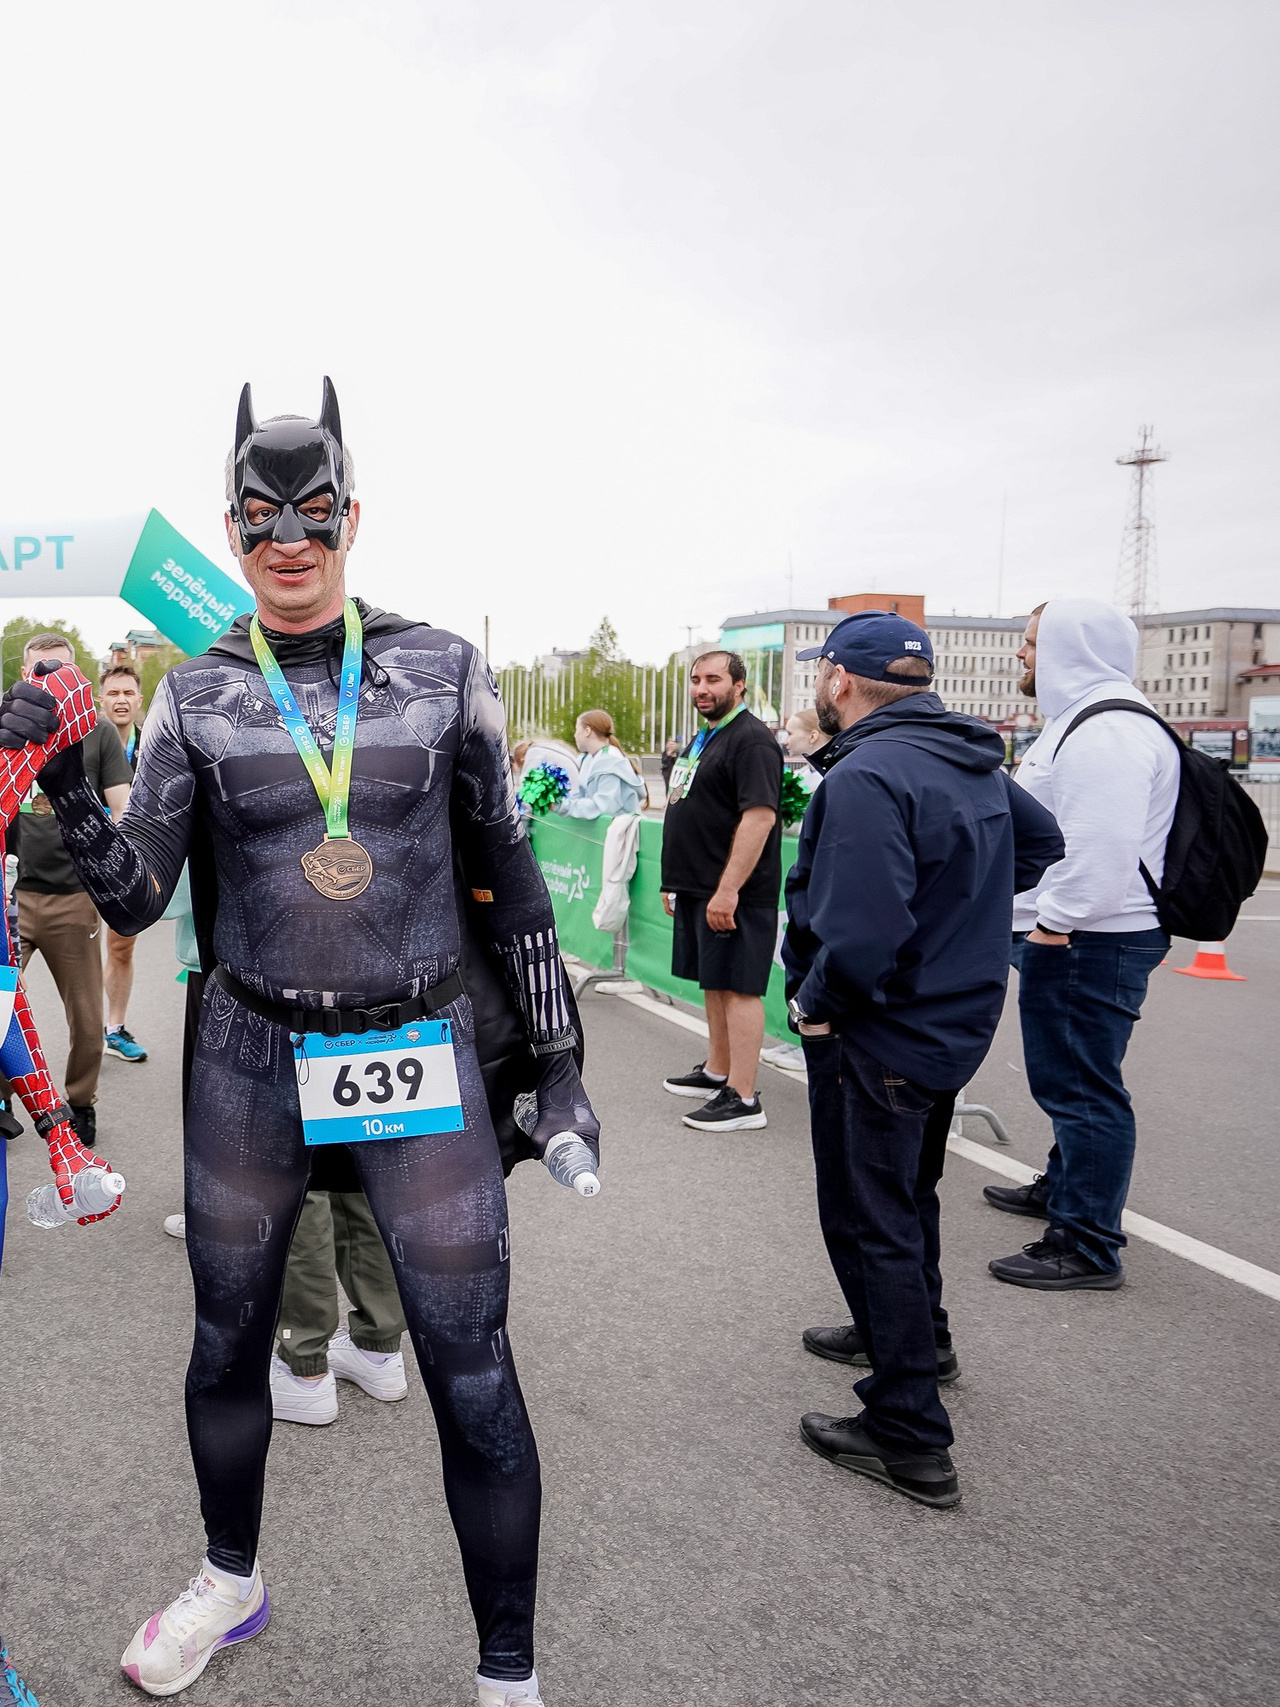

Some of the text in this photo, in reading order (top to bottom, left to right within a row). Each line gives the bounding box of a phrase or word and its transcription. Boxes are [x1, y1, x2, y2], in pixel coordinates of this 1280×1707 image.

[150, 570, 222, 634] марафон
[162, 558, 236, 621] зелёный
[300, 735, 315, 755] СБЕР
[342, 714, 350, 735] СБЕР
[333, 1057, 424, 1107] 639
